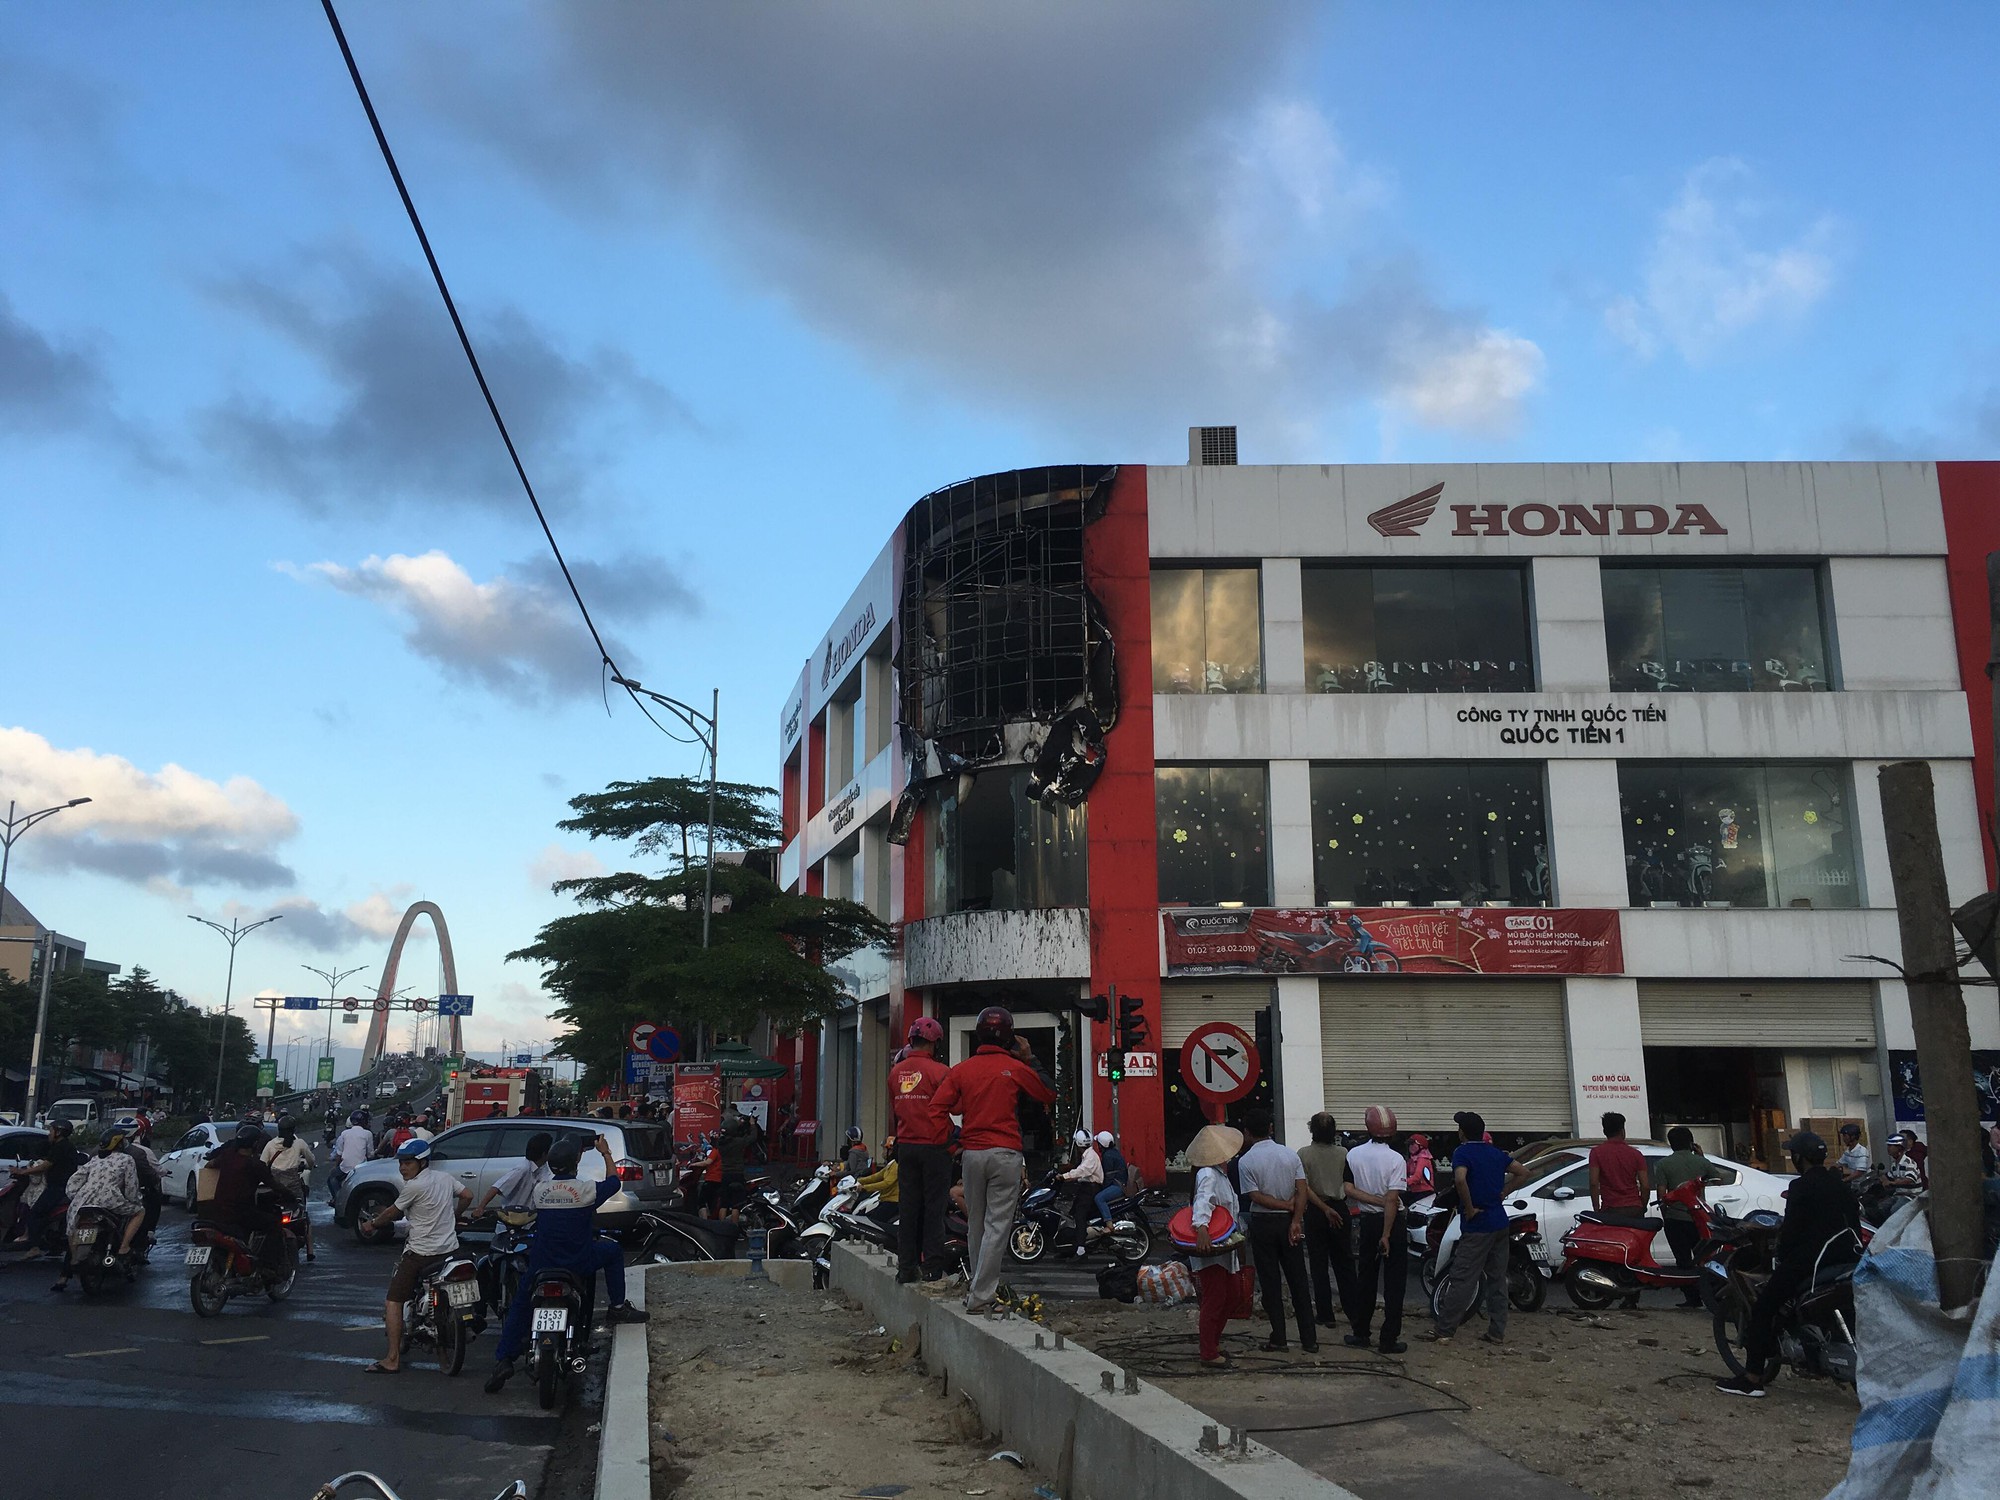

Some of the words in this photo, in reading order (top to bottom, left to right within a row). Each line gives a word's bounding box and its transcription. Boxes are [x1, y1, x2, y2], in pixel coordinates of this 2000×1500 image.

[1450, 503, 1728, 536] HONDA
[831, 602, 876, 680] HONDA
[1457, 705, 1502, 723] CÔNG
[1508, 709, 1529, 723] TY
[1534, 709, 1577, 723] TNHH
[1582, 703, 1627, 724] QUỐC
[1632, 703, 1667, 723] TIẾN
[1500, 722, 1559, 745] QUỐC
[1567, 722, 1611, 744] TIẾN
[1615, 728, 1625, 744] 1
[1200, 916, 1222, 926] QUỐC
[1223, 915, 1238, 925] TIẾN
[1509, 918, 1531, 929] TẶNG
[1536, 916, 1554, 930] 01
[1378, 923, 1413, 938] Xuân
[1413, 919, 1431, 938] gắn
[1431, 920, 1449, 938] kết
[1507, 931, 1519, 939] MŨ
[1519, 931, 1534, 939] BẢO
[1536, 930, 1553, 939] HIỂM
[1514, 938, 1535, 946] PHIẾU
[1574, 938, 1592, 947] MIỄN
[1187, 946, 1207, 955] 01.02
[1215, 945, 1256, 953] 28.02.2019
[1102, 1055, 1154, 1068] HAD
[1591, 1074, 1604, 1082] GIỜ
[1605, 1074, 1616, 1082] MỞ
[1617, 1074, 1631, 1082] CỬA
[552, 1183, 567, 1191] LIÊN
[567, 1186, 581, 1203] MINH
[538, 1310, 563, 1320] 43-S3
[536, 1321, 561, 1330] 8131
